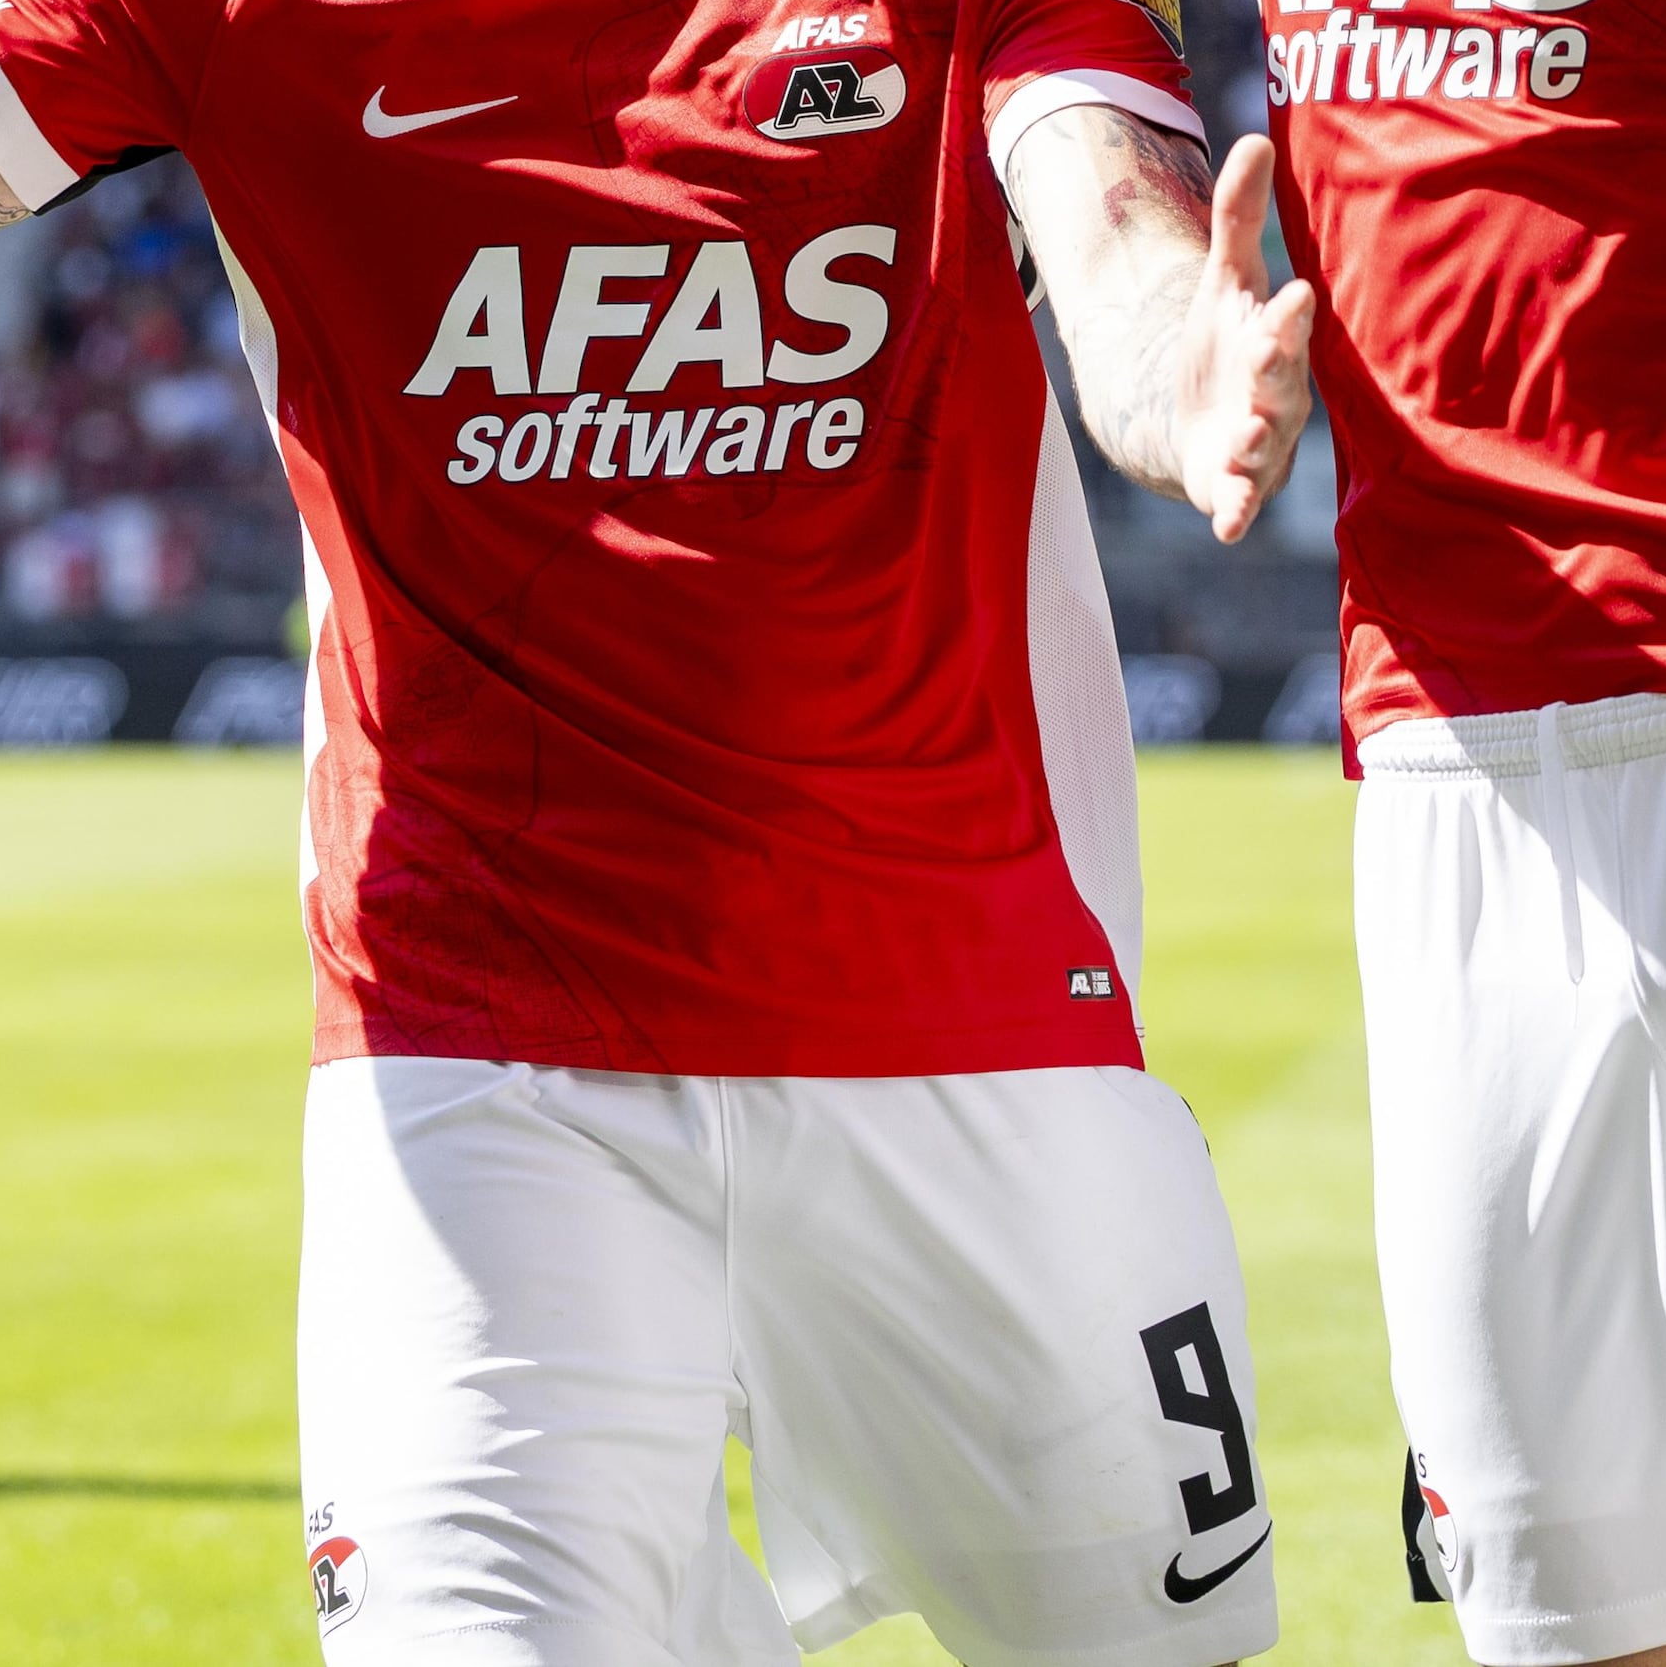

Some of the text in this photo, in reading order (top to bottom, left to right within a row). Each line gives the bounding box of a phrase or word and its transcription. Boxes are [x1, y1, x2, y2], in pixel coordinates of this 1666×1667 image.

[772, 14, 868, 53] AFAS
[1267, 8, 1588, 107] software
[774, 61, 884, 129] AZ
[401, 223, 898, 396] AFAS
[446, 393, 866, 486] software
[1139, 1300, 1258, 1536] 9
[307, 1501, 334, 1546] FAS
